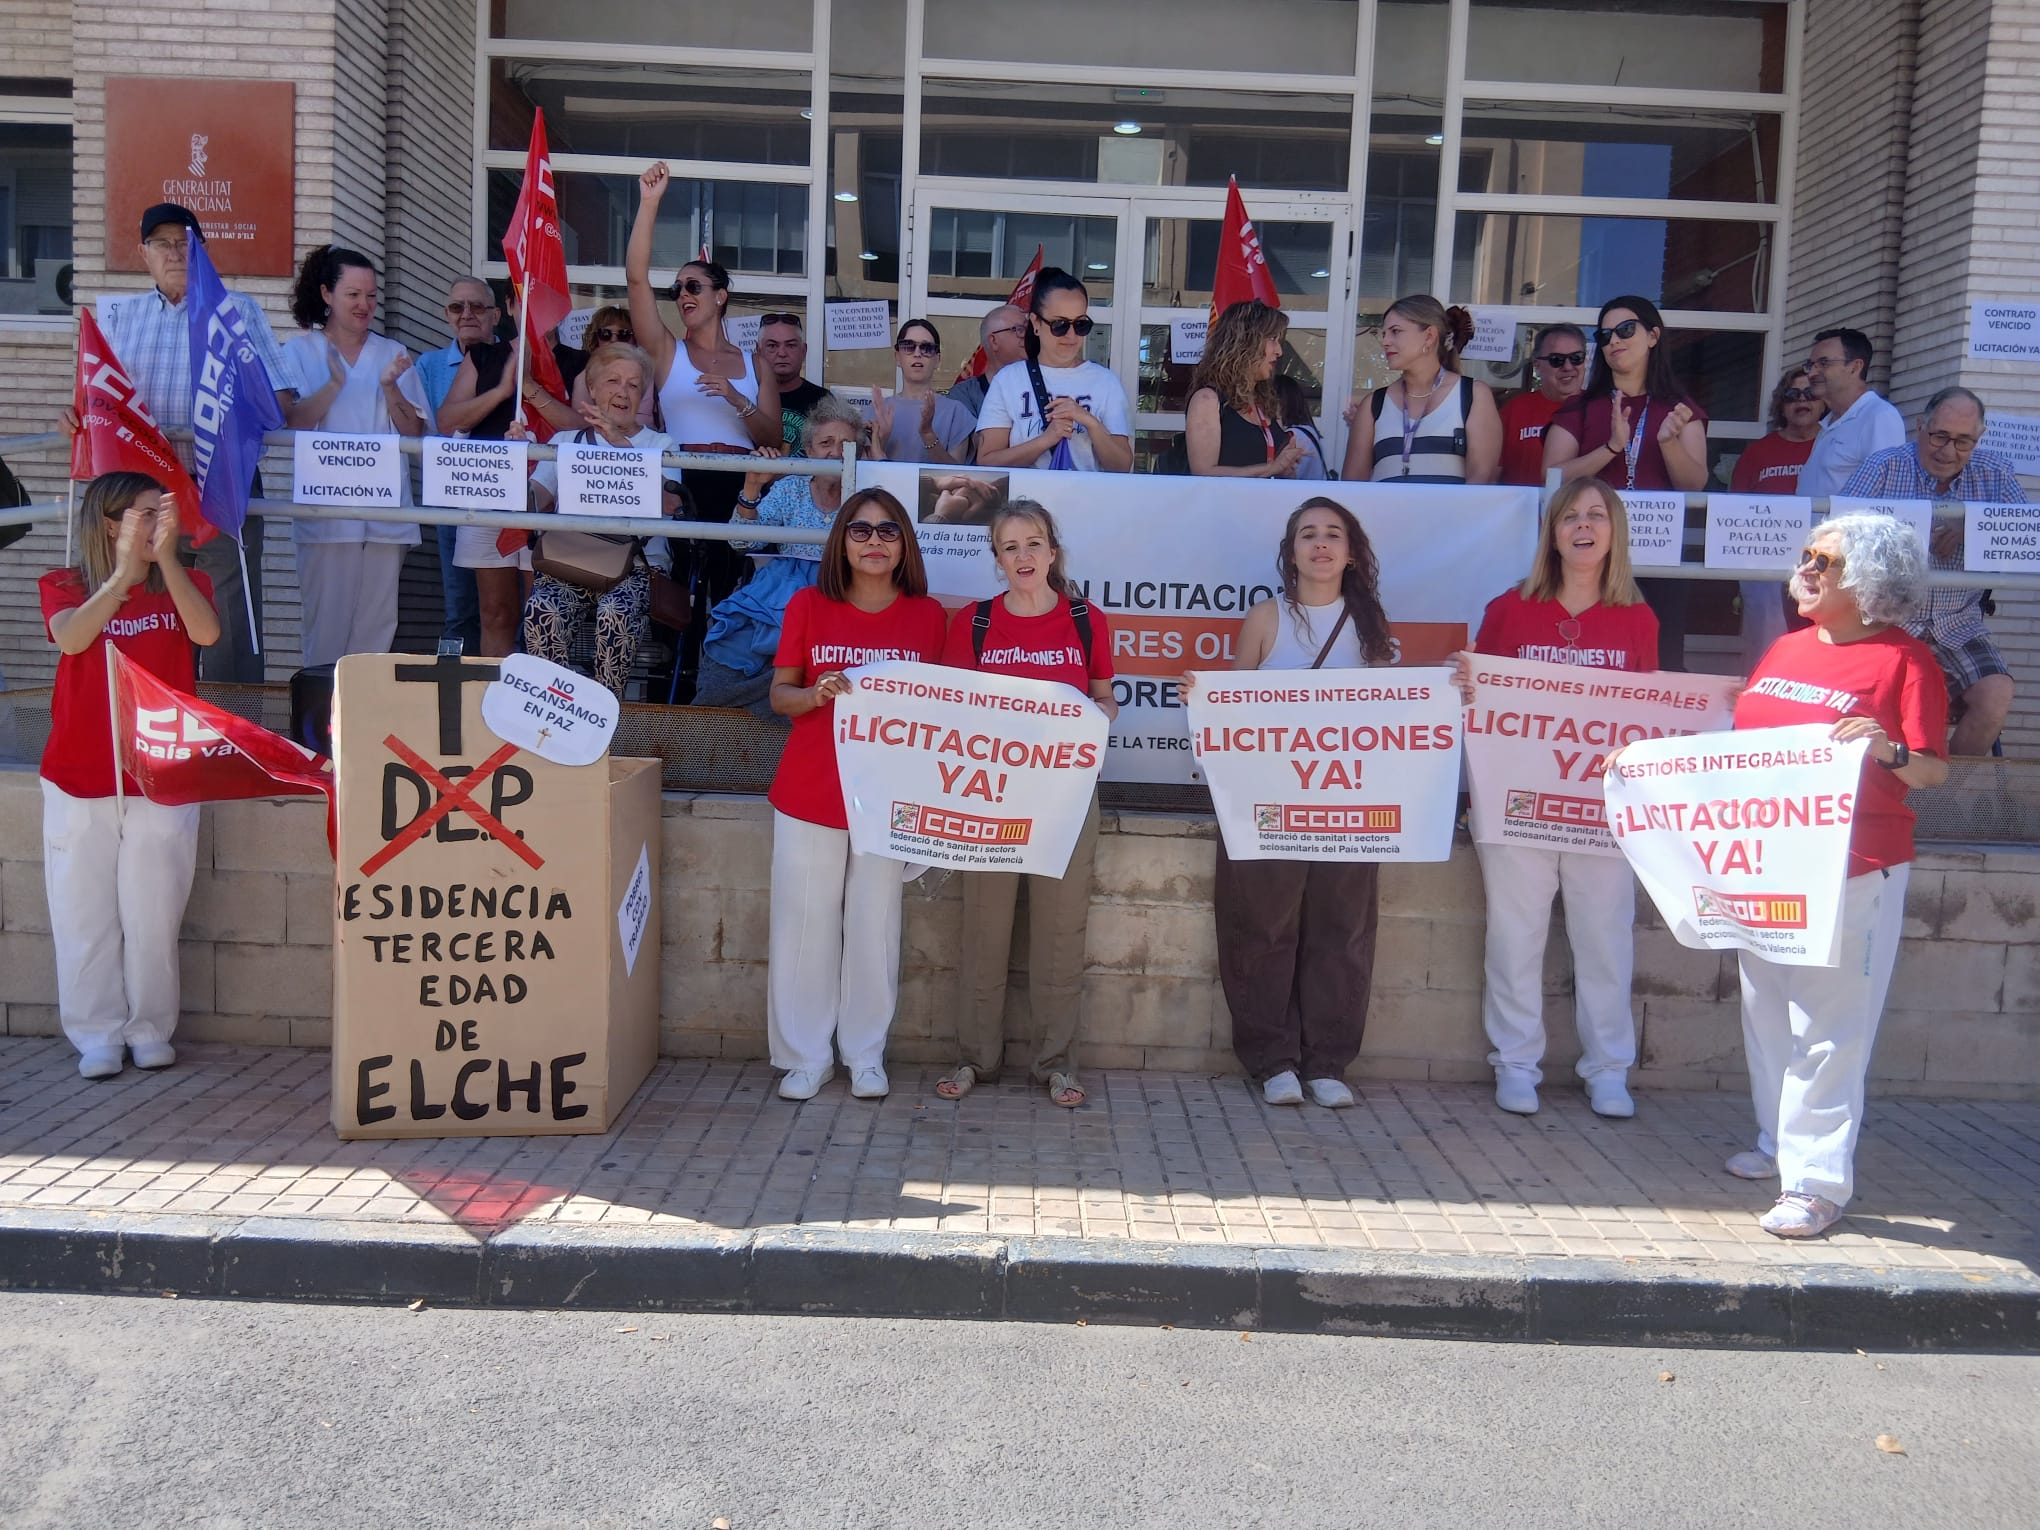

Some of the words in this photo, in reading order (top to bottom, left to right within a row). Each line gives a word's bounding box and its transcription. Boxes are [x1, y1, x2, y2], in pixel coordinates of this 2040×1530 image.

[163, 180, 232, 196] GENERALITAT
[1984, 308, 2036, 318] CONTRATO
[1181, 322, 1208, 330] CONTR
[1988, 320, 2031, 330] VENCIDO
[742, 330, 758, 338] AÑO
[1974, 343, 2026, 353] LICITACIÓN
[2028, 346, 2040, 354] YA
[1998, 422, 2040, 432] CONTRAT
[1988, 430, 2028, 441] ADUCADO
[312, 440, 381, 452] CONTRATO
[441, 442, 509, 455] QUEREMOS
[134, 440, 175, 472] ccoopv
[318, 454, 376, 468] VENCIDO
[436, 456, 514, 471] SOLUCIONES,
[576, 450, 644, 463] QUEREMOS
[451, 471, 468, 482] NO
[471, 470, 499, 484] MÁS
[571, 464, 649, 478] SOLUCIONES,
[302, 484, 373, 498] LICITACIÓN
[375, 486, 392, 498] YA
[444, 486, 506, 498] RETRASOS
[586, 479, 604, 490] NO
[606, 478, 634, 491] MÁS
[579, 492, 641, 506] RETRASOS
[1657, 513, 1674, 522] NO
[1984, 508, 2040, 518] QUEREMO
[1631, 526, 1652, 534] SER
[1655, 526, 1670, 534] LA
[1716, 516, 1781, 529] VOCACIÓN
[1784, 519, 1803, 529] NO
[1977, 521, 2040, 532] SOLUCIONE
[933, 530, 950, 542] día
[954, 532, 964, 542] tu
[966, 532, 993, 543] tamb
[1729, 532, 1761, 542] PAGA
[1764, 533, 1788, 542] LAS
[1990, 536, 2008, 546] NO
[2011, 534, 2037, 546] MÁS
[920, 546, 944, 555] erás
[946, 548, 982, 559] mayor
[1103, 581, 1278, 612] LICITACIO
[552, 677, 576, 695] NO
[1476, 672, 1585, 695] GESTIONES
[1589, 684, 1709, 712] INTEGRALES
[503, 672, 608, 729] DESCANSAMOS
[860, 676, 964, 703] GESTIONES
[968, 692, 1082, 718] INTEGRALES
[1207, 689, 1310, 704] GESTIONES
[1315, 687, 1430, 702] INTEGRALES
[1825, 690, 1859, 714] YA!
[523, 700, 543, 717] EN
[544, 709, 576, 732] PAZ
[136, 736, 191, 760] país
[839, 714, 1098, 769] ¡LICITACIONES
[1122, 736, 1143, 749] LA
[1147, 736, 1191, 751] TERC
[1196, 724, 1454, 758] ¡LICITACIONES
[1552, 750, 1606, 782] YA
[937, 761, 1008, 803] YA!
[1290, 759, 1362, 790] YA!
[1290, 810, 1364, 828] CCOO
[1504, 817, 1549, 830] federació
[1551, 821, 1563, 832] de
[1565, 823, 1598, 836] sanitat
[925, 814, 998, 840] CCOO
[890, 830, 931, 846] federació
[932, 836, 944, 847] de
[946, 840, 978, 853] sanitat
[984, 844, 1016, 854] sectors
[1300, 832, 1312, 842] de
[1314, 833, 1346, 842] sanitat
[1348, 834, 1352, 842] i
[1354, 834, 1390, 843] sectors
[1503, 828, 1570, 844] sociosanitaris
[1571, 835, 1586, 846] del
[1588, 837, 1609, 848] País
[890, 843, 950, 861] sociosanitaris
[952, 851, 966, 863] del
[968, 853, 987, 865] País
[988, 854, 1024, 865] Valencià
[1322, 844, 1336, 854] del
[1338, 844, 1359, 854] País
[1360, 844, 1400, 854] Valencià
[1692, 839, 1763, 876] YA!
[338, 882, 572, 922] ESIDENCIA
[1760, 931, 1795, 940] sectors
[363, 930, 555, 963] TERCERA
[420, 973, 528, 1007] EDAD
[435, 1019, 481, 1052] DE
[357, 1051, 589, 1126] ELCHE
